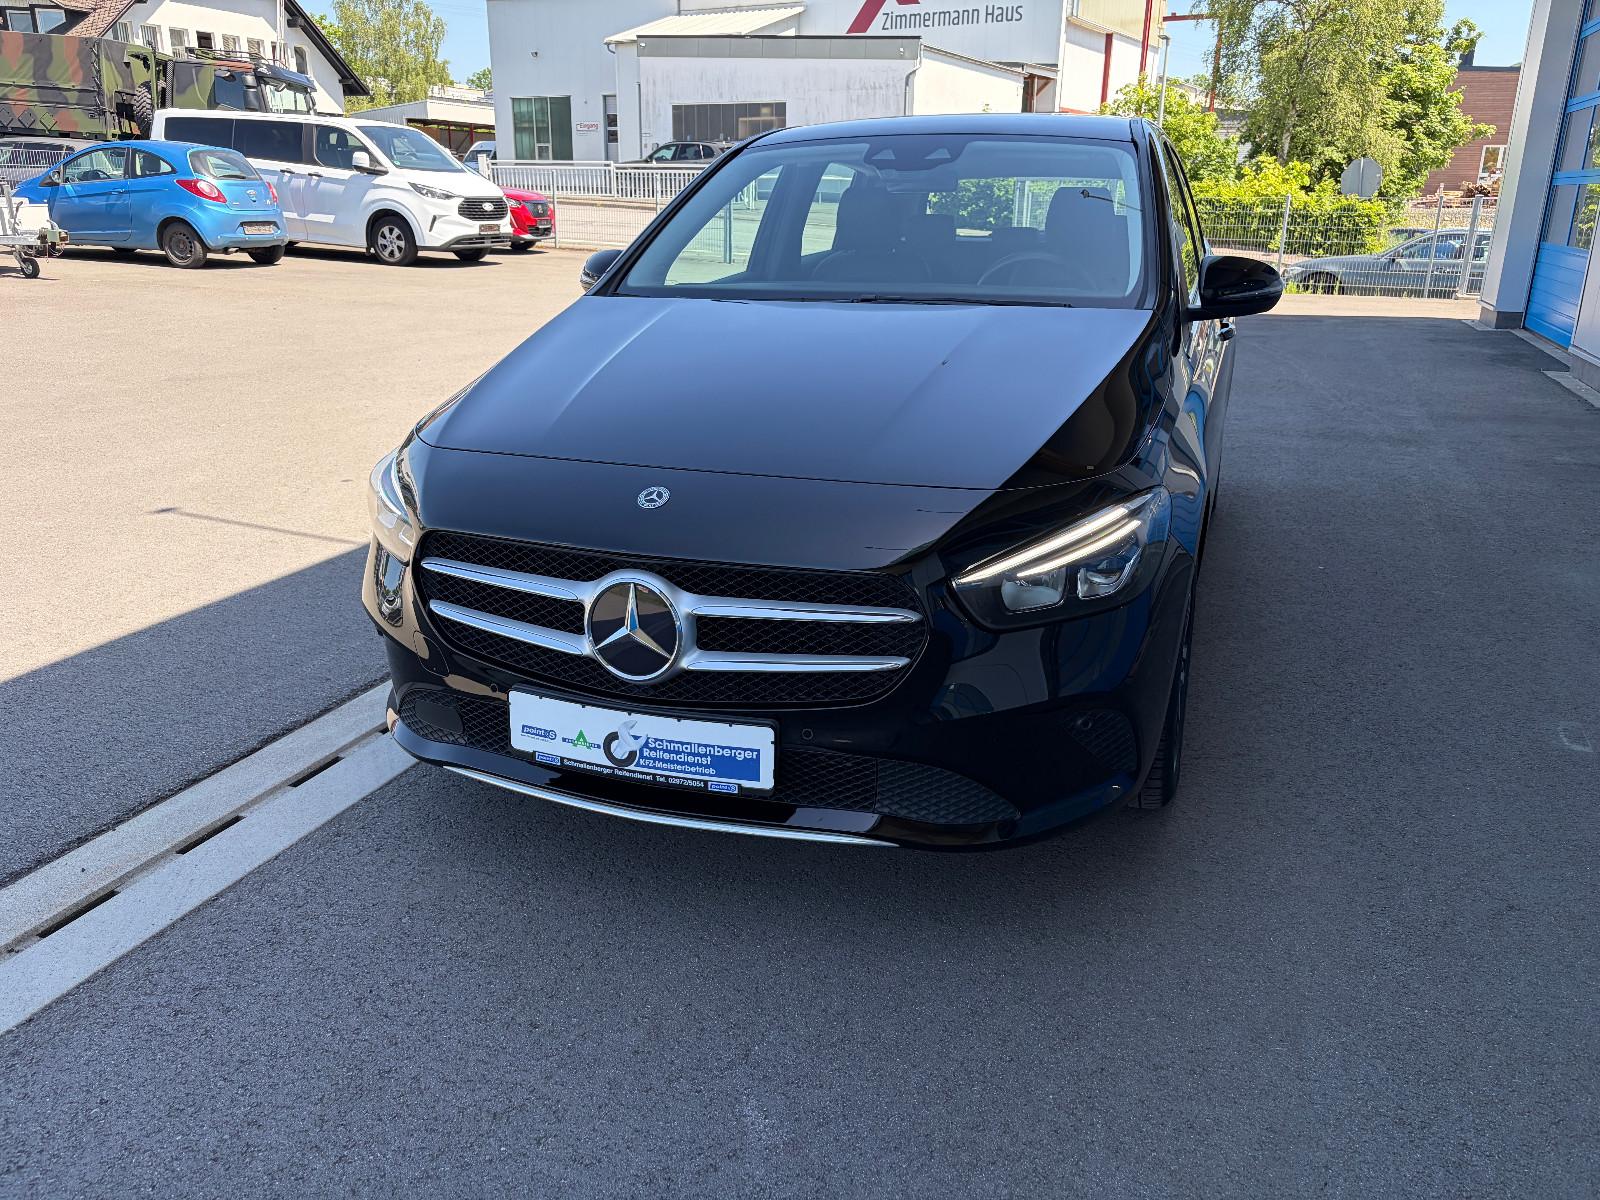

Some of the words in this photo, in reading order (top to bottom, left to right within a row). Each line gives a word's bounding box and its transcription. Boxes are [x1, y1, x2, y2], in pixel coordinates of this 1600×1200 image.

[882, 8, 980, 31] Zimmermann
[985, 5, 1023, 24] Haus
[580, 122, 598, 130] Eingang
[643, 748, 712, 765] Reifendienst
[648, 738, 758, 761] Schmallenberger
[563, 758, 613, 774] Schmallenberger
[614, 768, 653, 781] Reifendienst
[656, 775, 666, 783] Tel.
[668, 777, 704, 788] 02972/5054
[639, 758, 716, 775] KFZ-Meisterbetrieb
